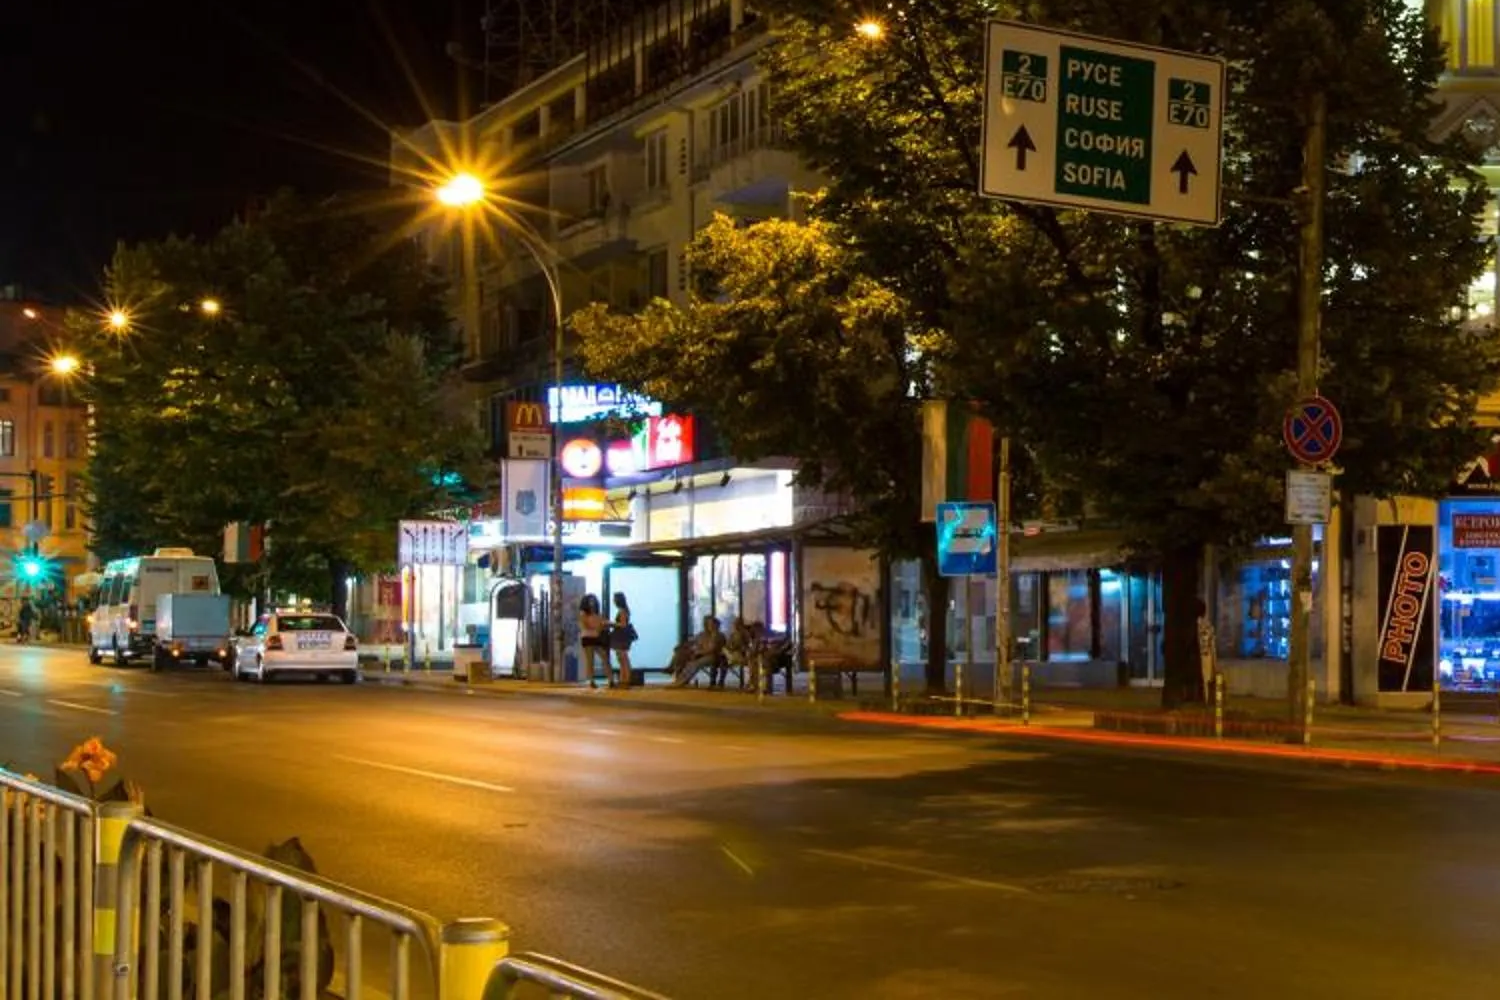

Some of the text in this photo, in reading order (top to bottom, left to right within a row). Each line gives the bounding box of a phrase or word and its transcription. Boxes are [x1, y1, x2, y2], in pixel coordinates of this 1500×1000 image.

[1018, 55, 1030, 74] 2
[1067, 60, 1122, 86] РУСЕ
[1003, 76, 1044, 100] E70
[1184, 83, 1196, 101] 2
[1066, 94, 1122, 121] RUSE
[1169, 104, 1208, 126] E70
[1065, 128, 1144, 159] СОФИЯ
[1064, 162, 1125, 190] SOFIA
[1383, 551, 1429, 663] PHOTO
